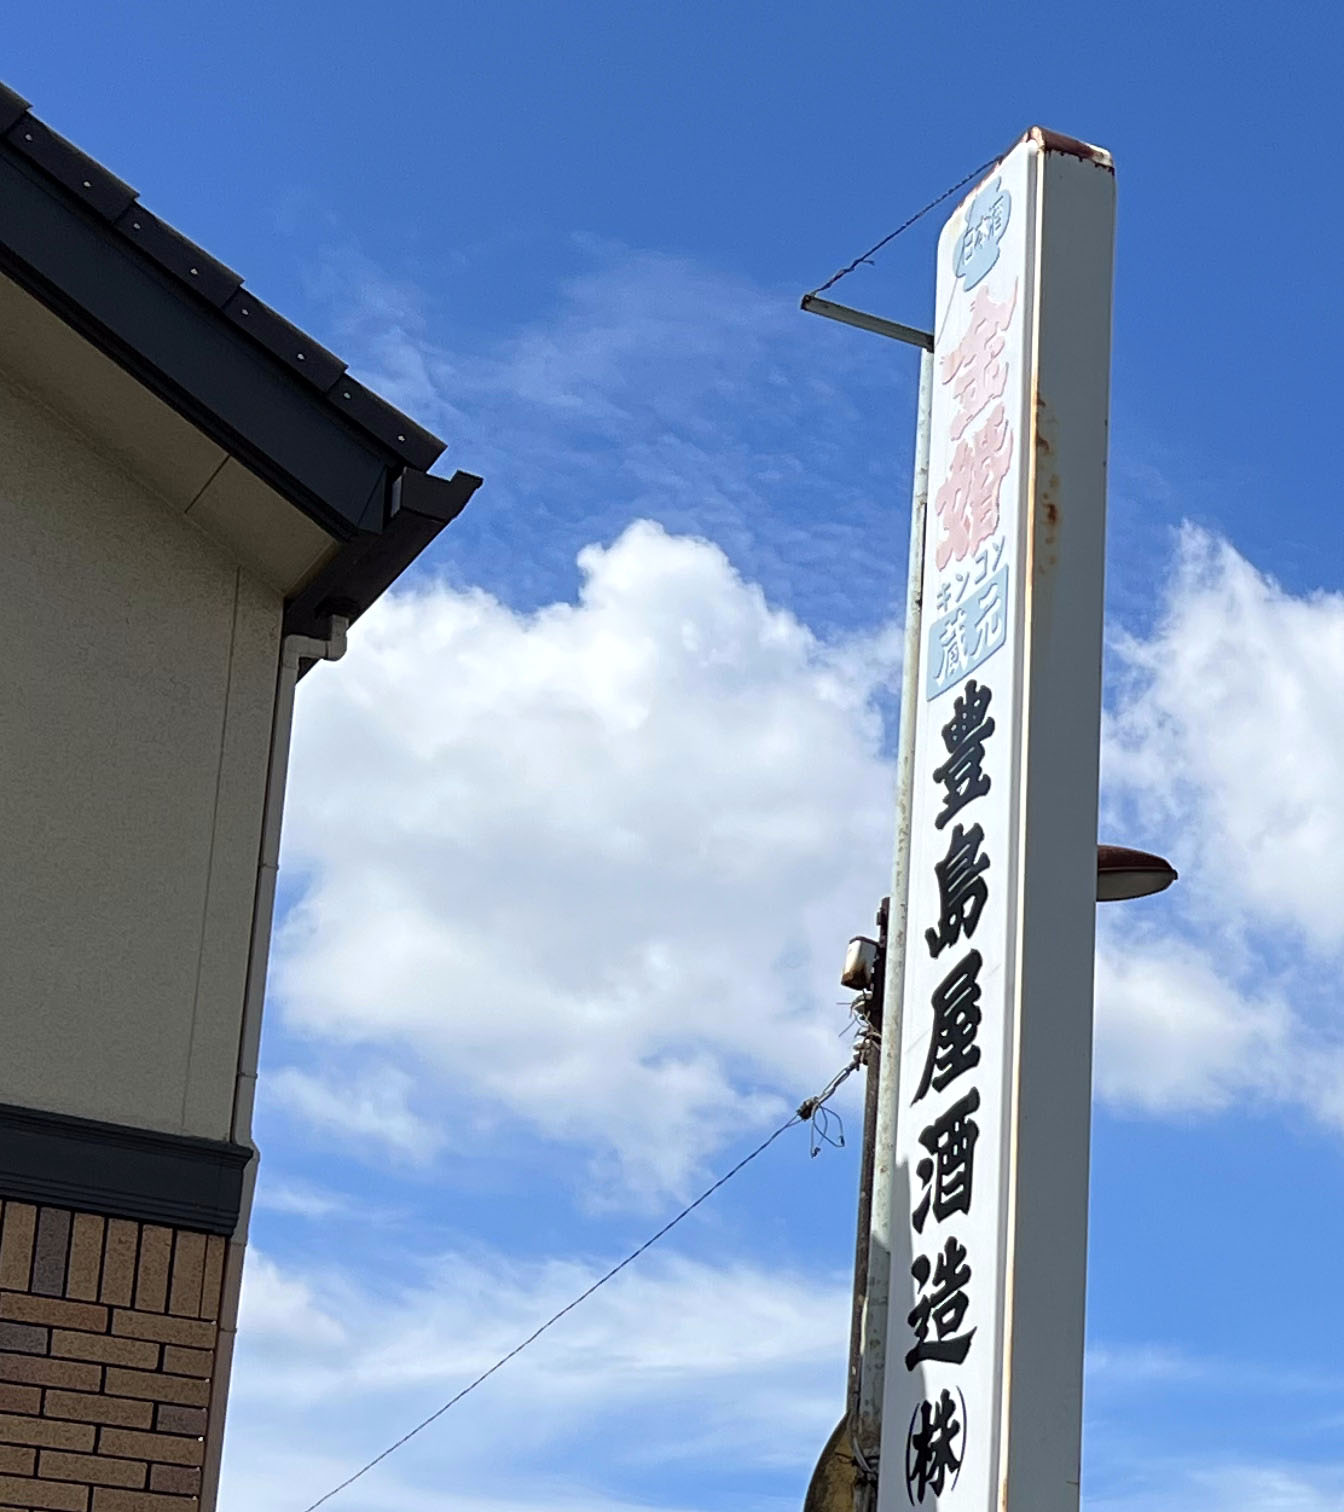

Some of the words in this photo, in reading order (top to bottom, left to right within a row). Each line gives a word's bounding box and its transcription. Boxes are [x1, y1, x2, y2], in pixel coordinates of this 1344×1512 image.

[936, 276, 1018, 571] 金婚
[936, 536, 1005, 612] キンコン
[933, 582, 1002, 686] 蔵元
